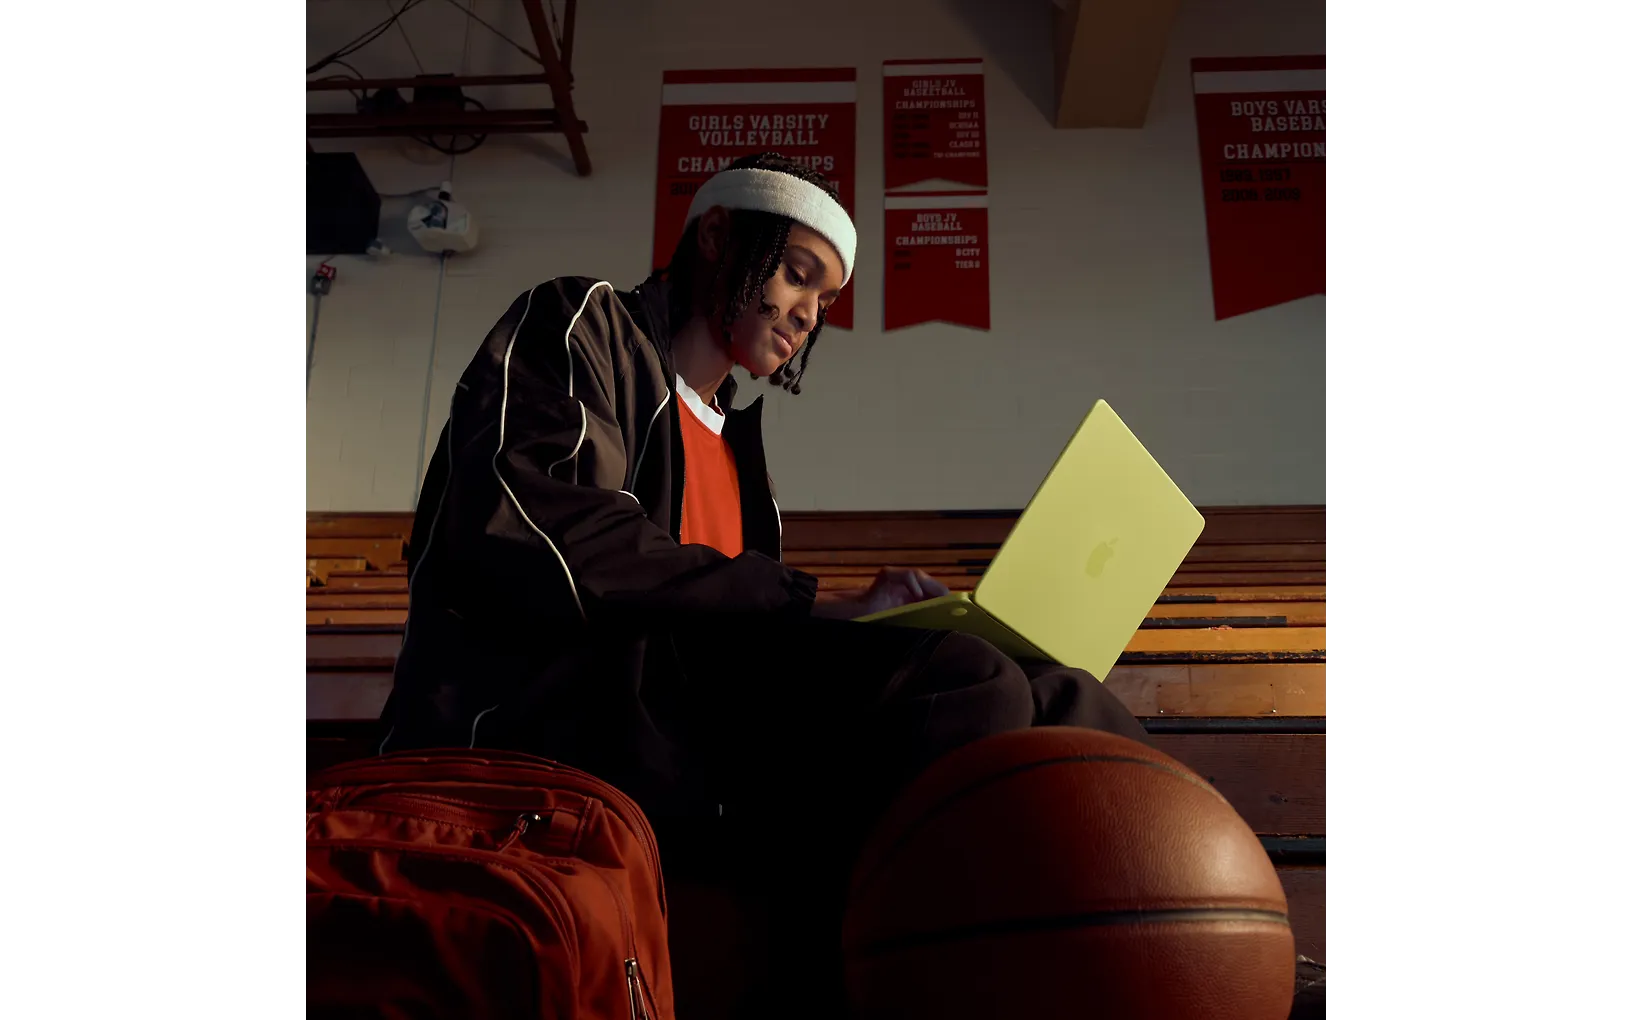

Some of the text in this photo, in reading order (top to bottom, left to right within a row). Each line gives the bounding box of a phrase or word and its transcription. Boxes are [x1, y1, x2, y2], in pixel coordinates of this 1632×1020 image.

[912, 79, 956, 89] GIRLS JV
[904, 87, 966, 96] BASKETBALL
[895, 99, 976, 109] CHAMPIONSHIPS
[1230, 101, 1278, 116] BOYS
[689, 114, 829, 130] GIRLS VARSITY
[699, 131, 818, 146] VOLLEYBALL
[917, 213, 957, 222] BOYS JV
[911, 221, 963, 231] BASEBALL
[895, 235, 978, 245] CHAMPIONSHIPS
